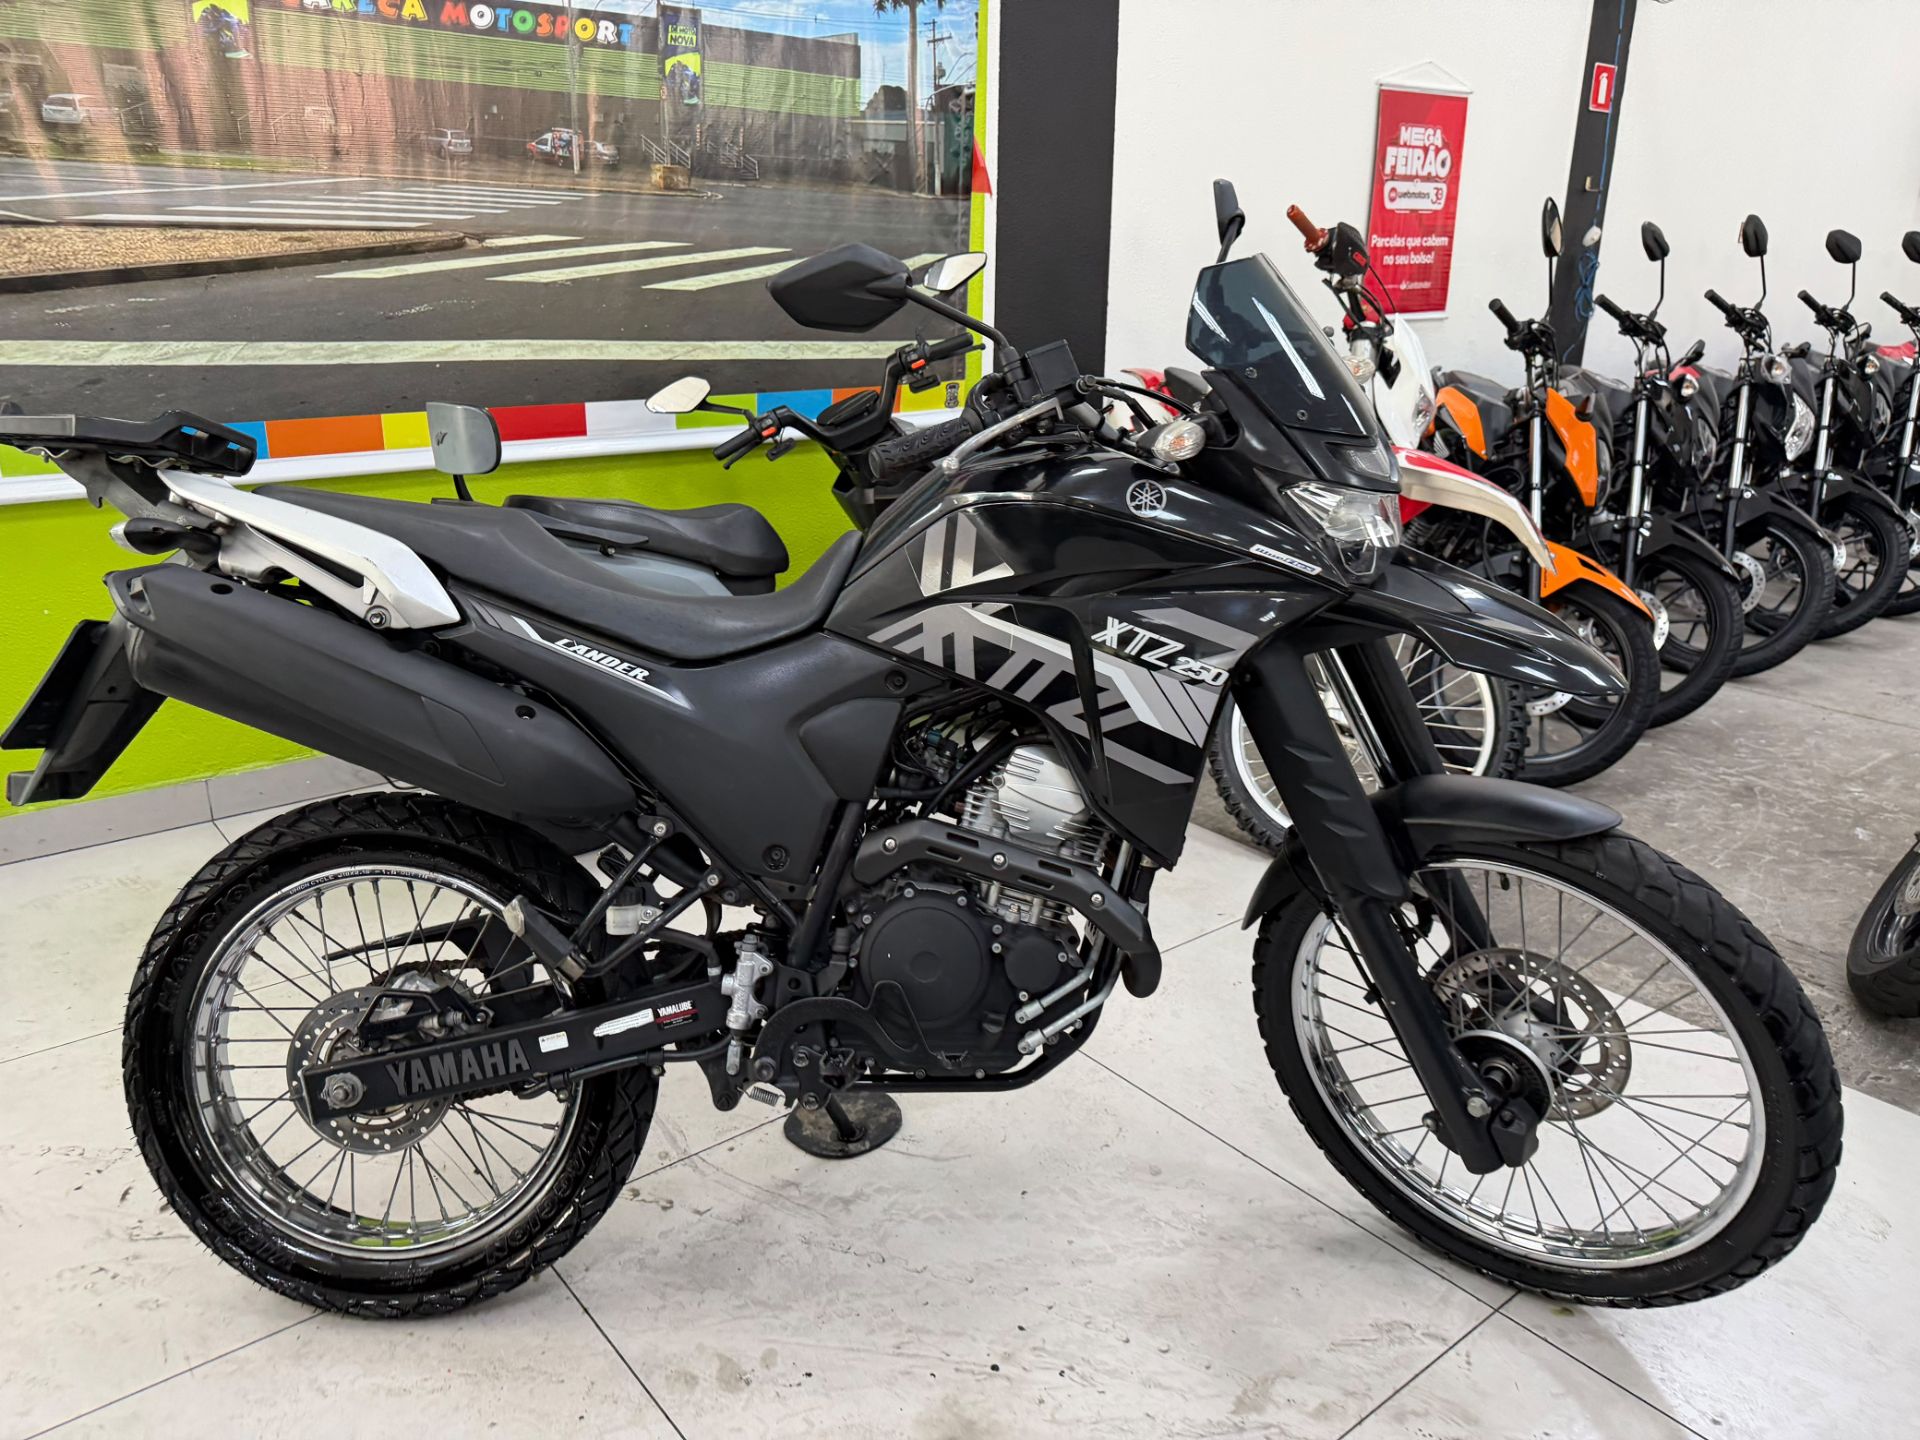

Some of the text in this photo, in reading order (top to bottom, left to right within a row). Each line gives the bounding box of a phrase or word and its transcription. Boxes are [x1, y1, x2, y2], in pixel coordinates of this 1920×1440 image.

[439, 2, 635, 46] MOTOSPORT
[670, 34, 695, 46] NOVA
[1400, 126, 1442, 148] MEGA
[1384, 145, 1451, 178] FEIRÃO
[1398, 190, 1430, 199] webmotors
[1371, 234, 1449, 250] Parcelas que cabem
[1383, 251, 1435, 265] no seu bolso!
[554, 638, 650, 681] LANDER
[1090, 616, 1230, 686] XTZ 250
[657, 1000, 693, 1017] YAMALUBE
[385, 1038, 531, 1097] YAMAHA
